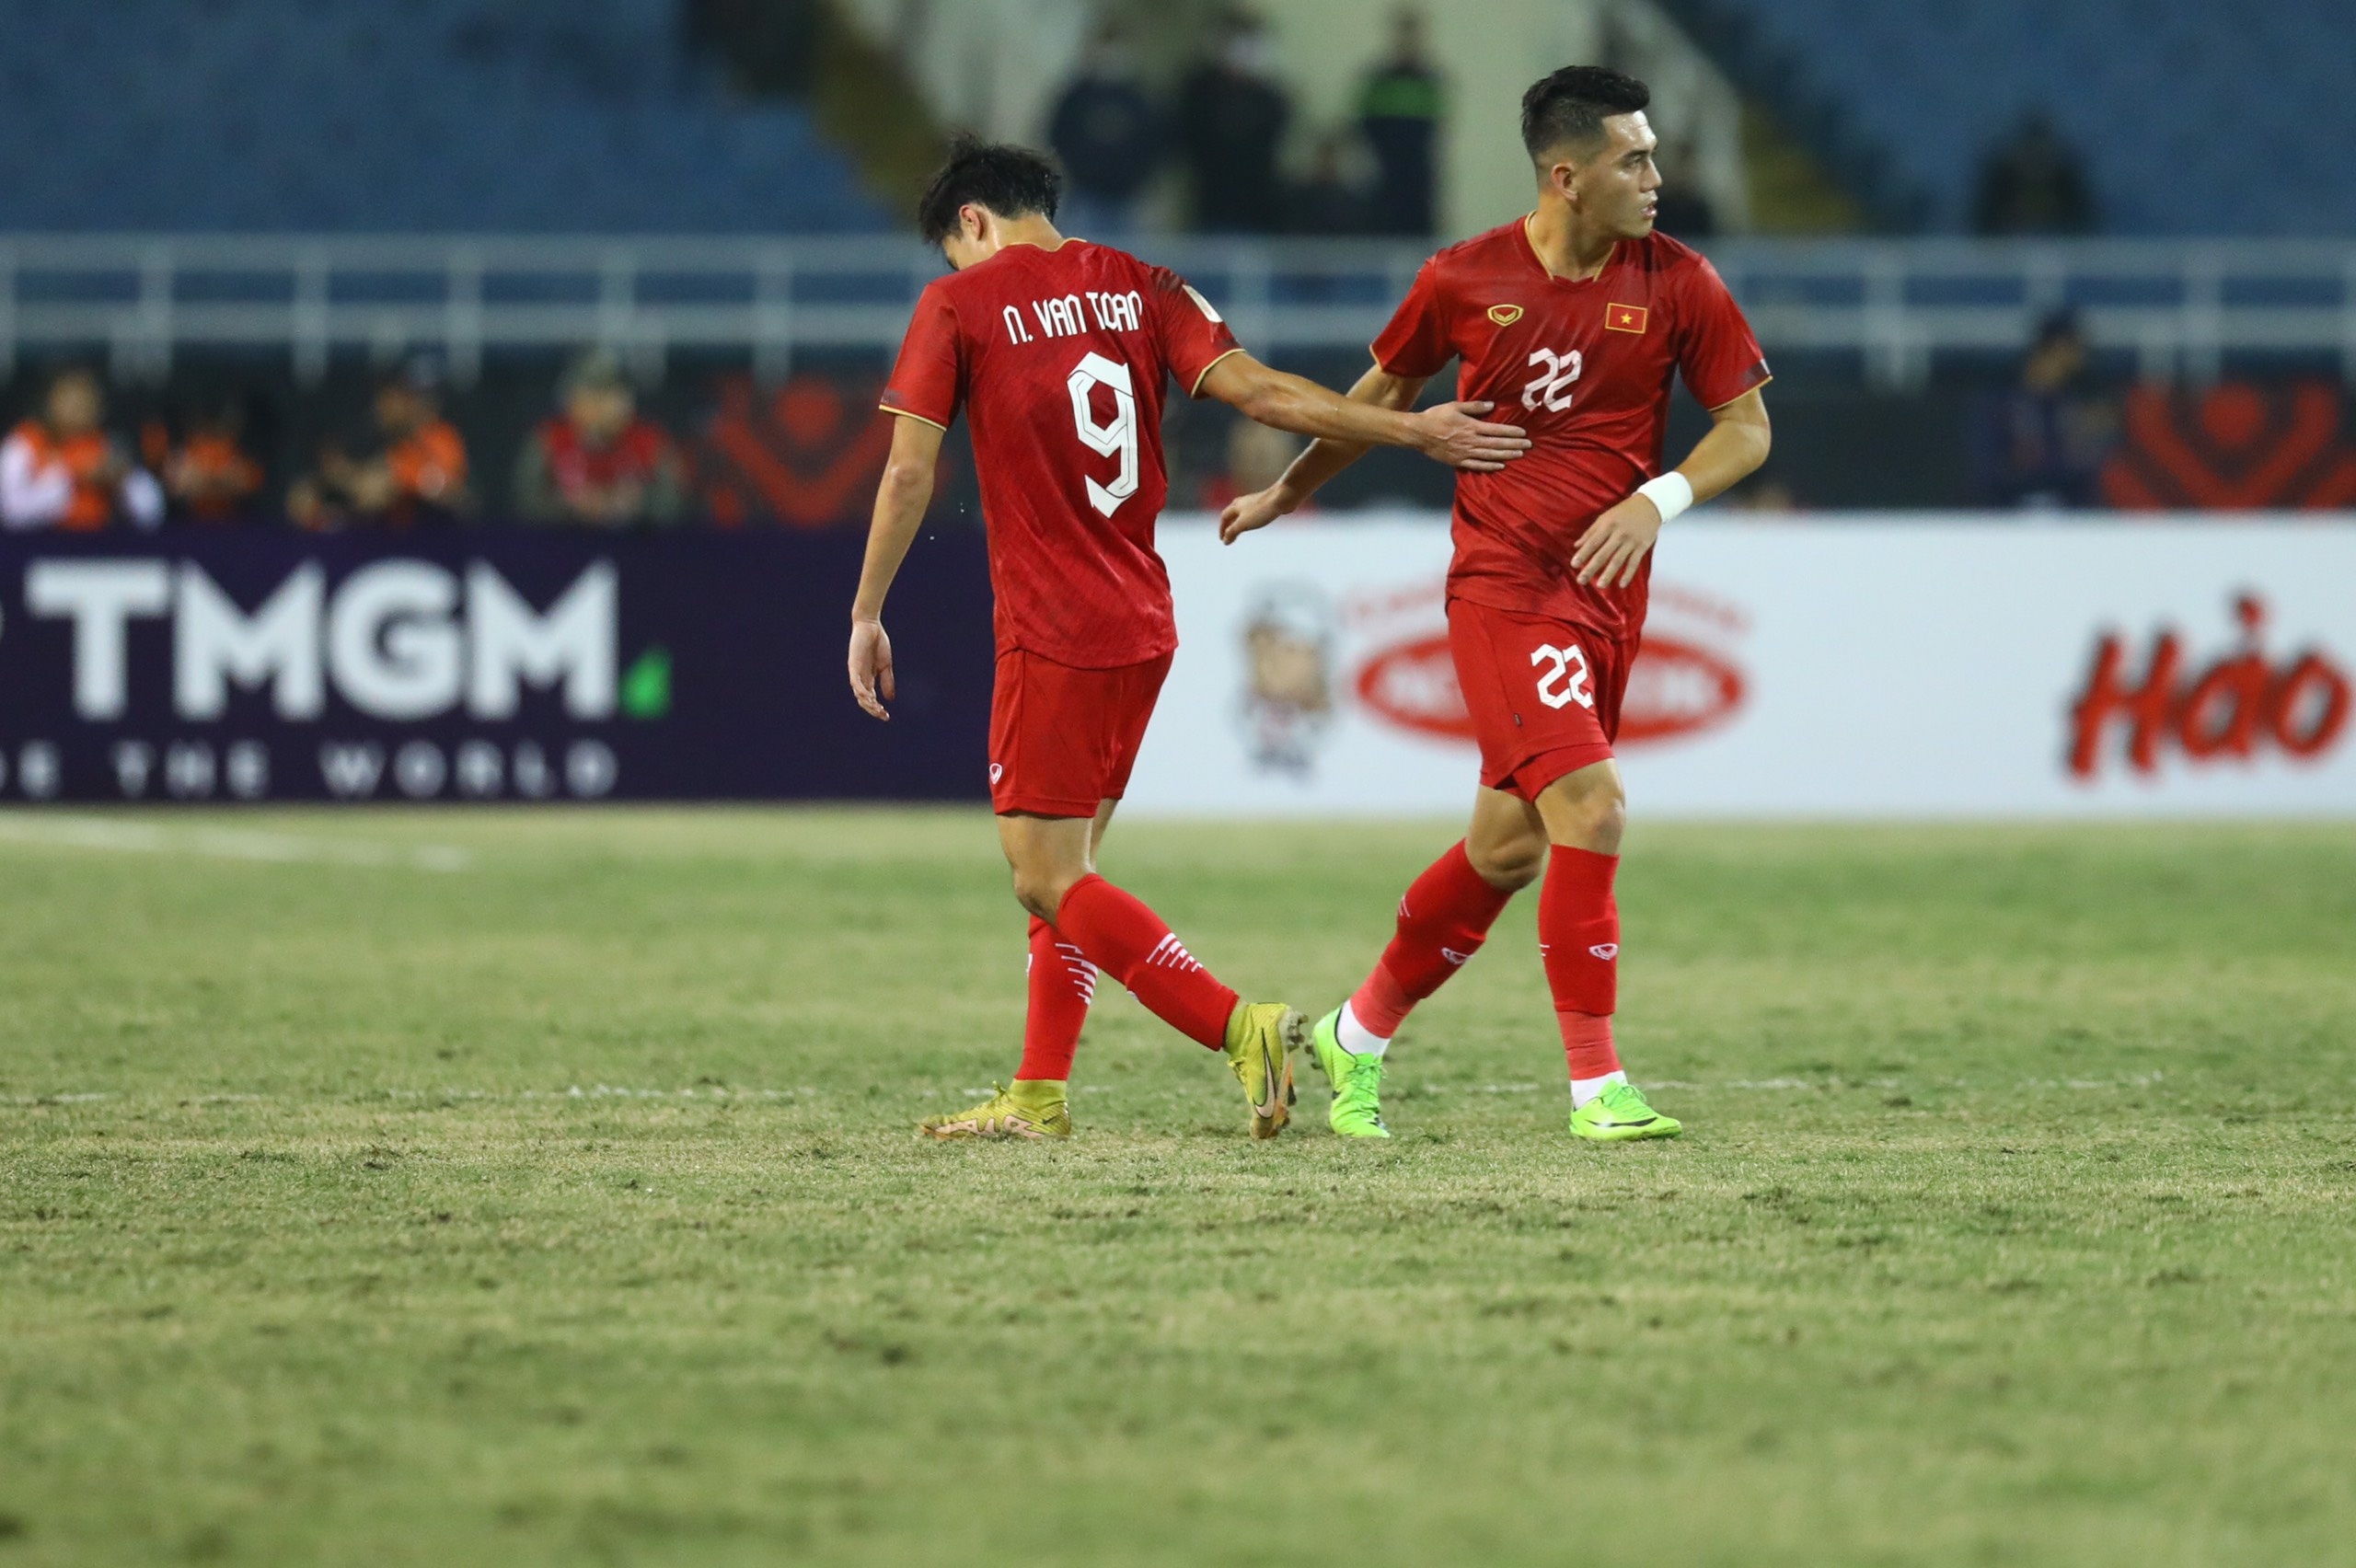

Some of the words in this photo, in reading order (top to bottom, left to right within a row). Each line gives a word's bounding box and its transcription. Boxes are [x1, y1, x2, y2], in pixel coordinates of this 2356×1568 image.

[1032, 294, 1088, 339] VAN
[1085, 290, 1143, 332] TOAN
[1521, 347, 1582, 412] 22
[1066, 351, 1139, 519] 9
[24, 559, 618, 721] TMGM
[1530, 643, 1594, 709] 22
[111, 740, 269, 798] THE
[318, 740, 618, 798] WORLD
